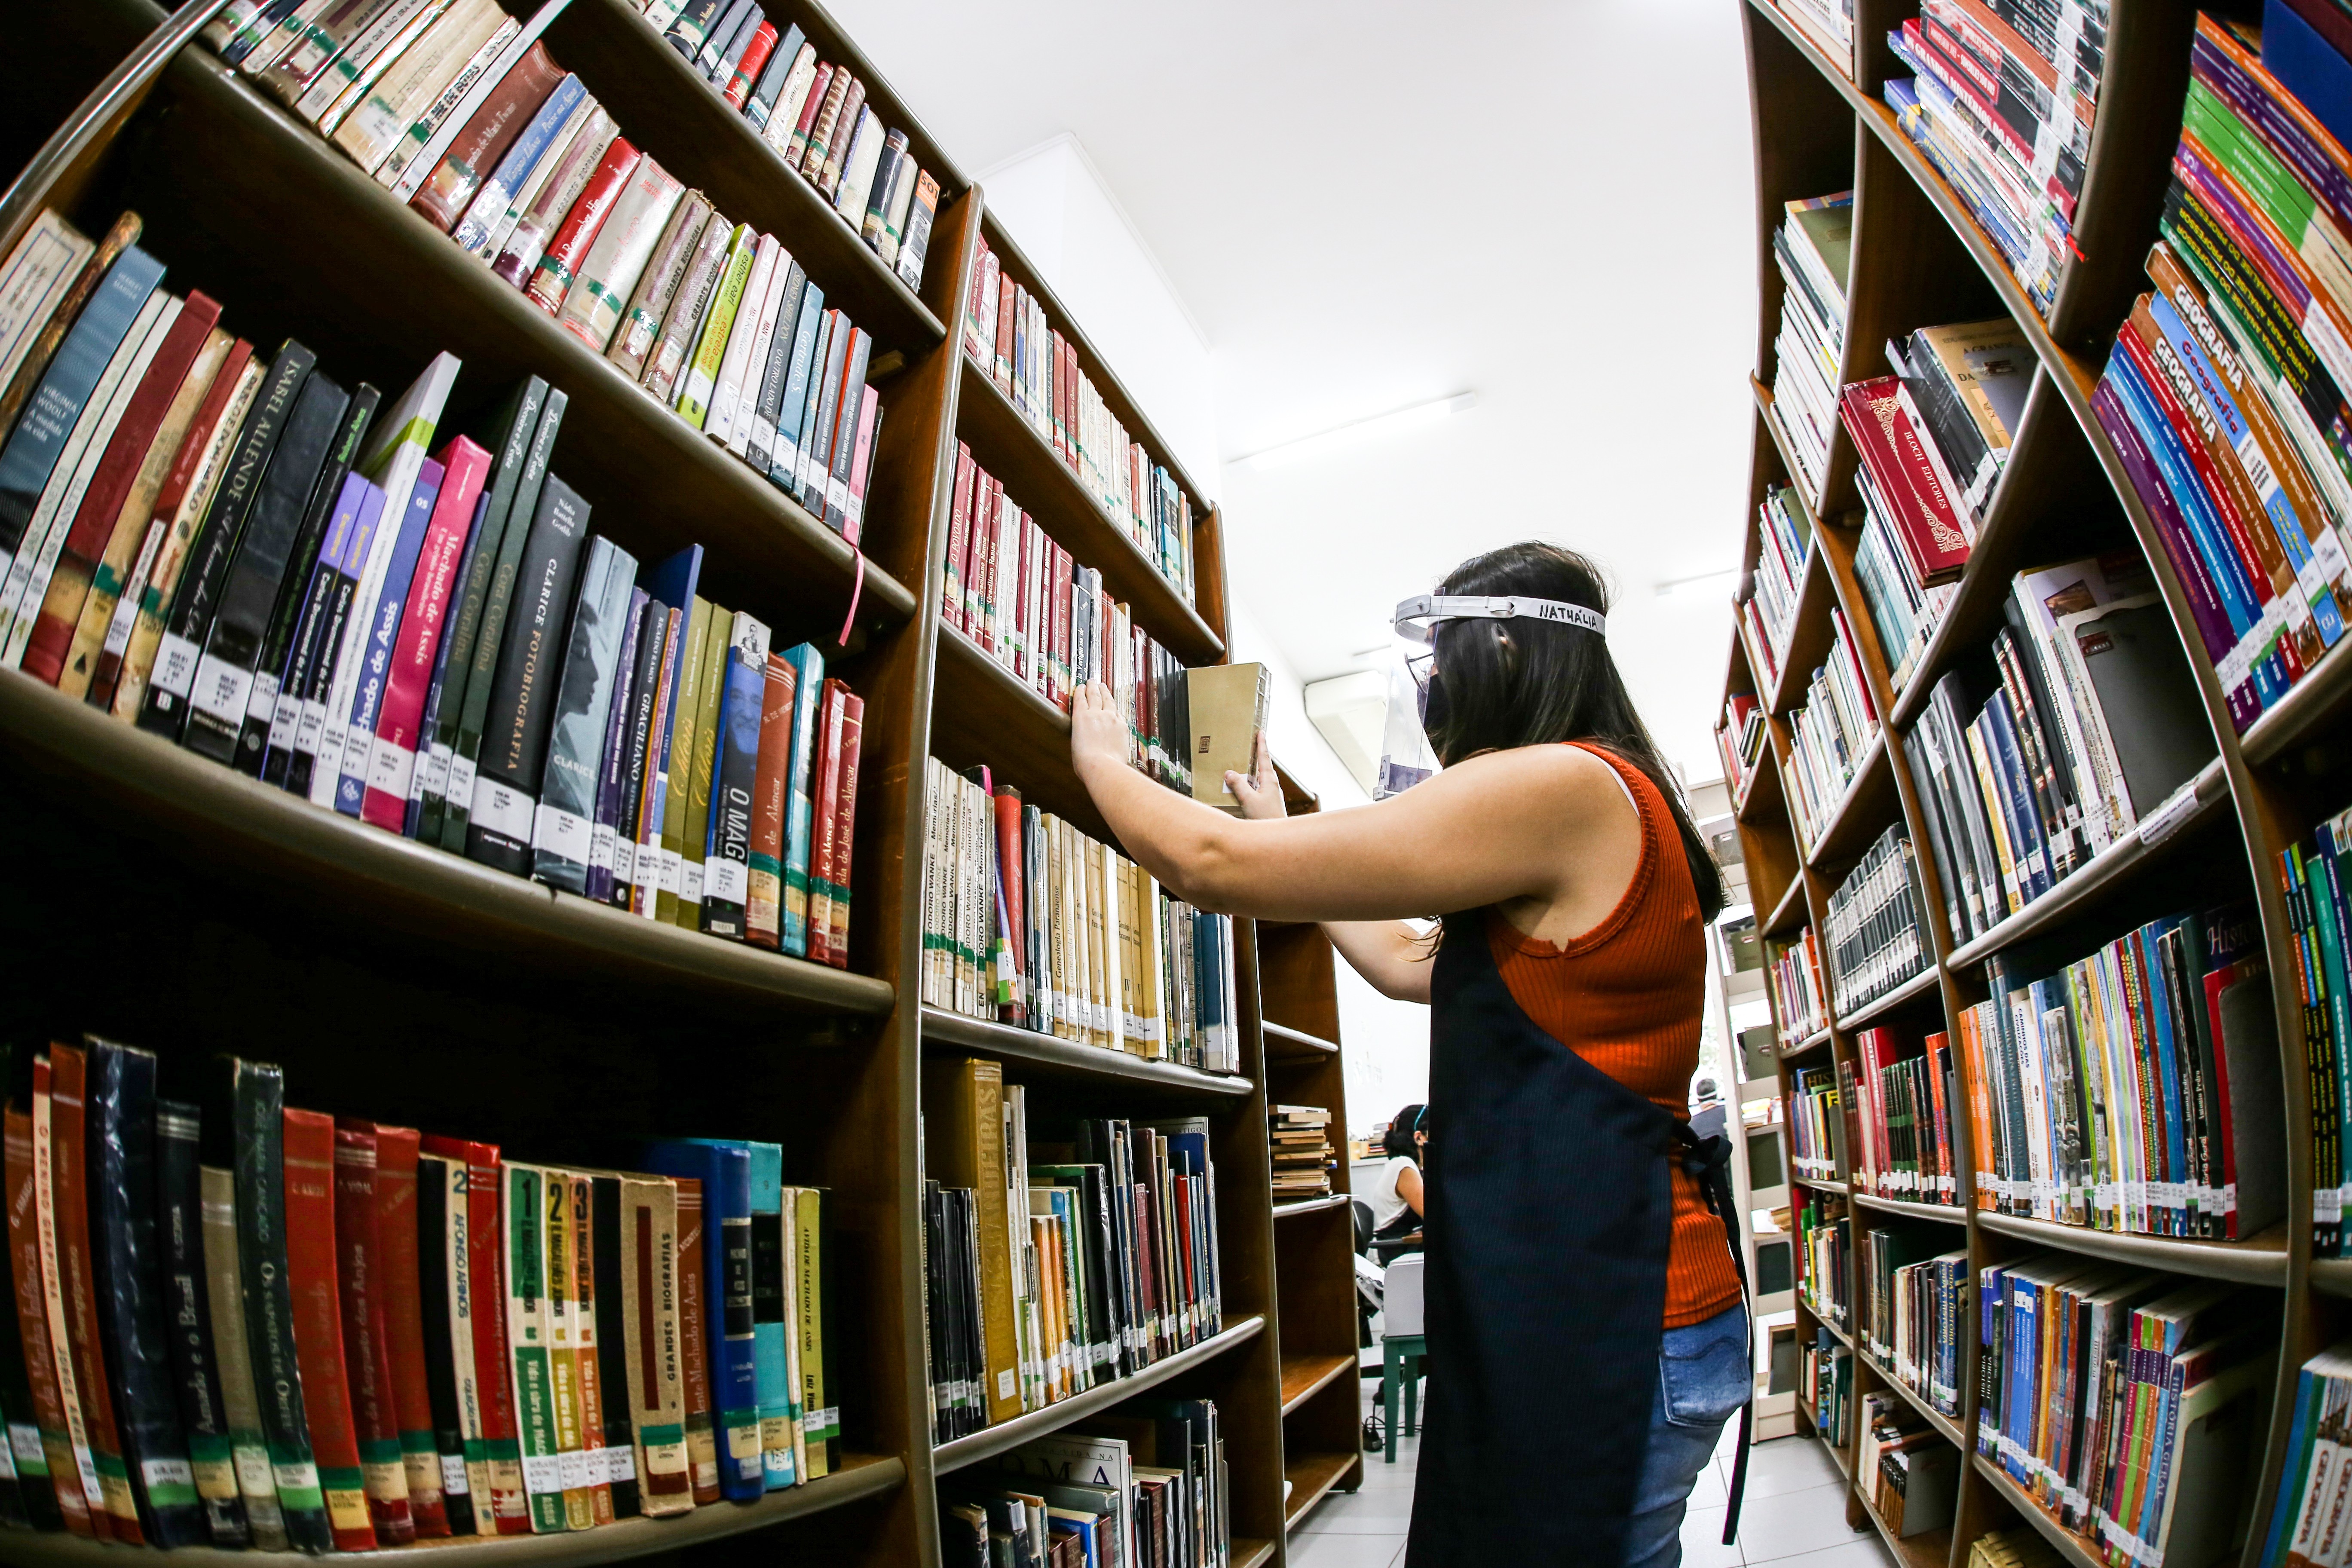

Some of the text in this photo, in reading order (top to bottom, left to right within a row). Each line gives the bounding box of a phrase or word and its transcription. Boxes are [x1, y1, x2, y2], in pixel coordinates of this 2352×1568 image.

[371, 4, 410, 42] QUE NÃO ERA
[1911, 43, 1951, 83] GRANDES
[1944, 75, 1998, 129] MISTÉRIOS
[476, 119, 502, 150] de Mark
[922, 175, 938, 199] 501
[619, 215, 641, 247] tempo
[662, 225, 703, 300] GRANDES BIOGRAFIAS
[727, 254, 751, 306] esther earl
[2182, 189, 2319, 364] LIVRO PARA ANÁLISE DO PROFESSOR
[788, 271, 802, 300] SIDNEY
[2178, 205, 2311, 381] LIVRO PARA ANÁLISE DO PROFESSOR
[710, 304, 727, 337] nunca vai
[778, 301, 795, 343] SHELDON
[2175, 222, 2306, 396] LIVRO PARA ANÁLISE DO PROFESSOR
[705, 321, 731, 370] estrela que
[736, 306, 757, 358] MAN Repeller
[749, 320, 771, 372] MAN Repeller
[2172, 282, 2248, 392] GEOGRAFIA
[771, 355, 783, 383] OUTRO
[790, 331, 815, 394] Gertrude S.
[1958, 372, 1976, 383] DA
[38, 397, 65, 420] WOOLF
[44, 385, 77, 414] VIRGINIA
[766, 383, 777, 406] LADO
[2153, 337, 2219, 441] GEOGRAFIA
[2178, 339, 2242, 435] Geografia
[229, 360, 299, 500] ISABEL ALLENDE
[763, 405, 772, 418] DE
[1902, 429, 1951, 511] BLOCH EDITORES
[2205, 470, 2227, 510] GEOGRAFIA
[416, 497, 427, 509] 05
[947, 509, 967, 562] O POVOADO
[979, 536, 988, 560] Ramos
[1043, 540, 1052, 569] GRACILIANO
[2184, 503, 2231, 593] MUNDO SUBDESENVOLVIDO
[984, 542, 998, 602] Graciliano Ramos
[2176, 527, 2218, 610] O MUNDO DESENVOLVIDO
[412, 532, 459, 666] Machado de Assis
[475, 563, 514, 671] Cora Coralina
[1041, 590, 1049, 617] MEMÓRIAS
[1539, 604, 1599, 630] NATHÁLIA
[371, 600, 398, 674] de Assis
[1058, 598, 1069, 658] Meus Verdes Anos
[505, 559, 557, 769] CLARICE FOTOBIOGRAFIA
[629, 693, 652, 781] GRACILIANO
[554, 754, 594, 779] CLARICE
[729, 787, 750, 805] O
[766, 778, 780, 845] de Alencar
[836, 764, 855, 864] de José de Alencar
[824, 818, 833, 856] Alencar
[1053, 885, 1063, 977] Genealogia Paranaense
[978, 992, 984, 1007] EN
[1124, 978, 1130, 992] IV
[2014, 1014, 2024, 1065] CIVILIZAÇÕES
[2335, 994, 2352, 1124] GEOGRAFIA GERAL
[2136, 1060, 2145, 1099] HISTÓRIA
[1172, 1125, 1202, 1136] ANTIGO
[2321, 1121, 2327, 1134] DO
[2330, 1114, 2335, 1129] DO
[2142, 1124, 2151, 1176] NAVEGANDO
[2199, 1136, 2209, 1161] Geral
[522, 1179, 532, 1217] 1
[550, 1184, 562, 1221] 2
[575, 1183, 587, 1218] 3
[451, 1170, 470, 1318] 2 AFONSO ARINOS
[661, 1234, 676, 1380] GRANDES BIOGRAFIAS
[683, 1273, 702, 1381] Machado de Assis
[1941, 1300, 1949, 1344] HISTÓRIA
[1947, 1302, 1957, 1346] HISTÓRIA
[806, 1375, 815, 1389] Luiz
[1978, 1354, 1988, 1397] HISTÓRIA
[1984, 1356, 1995, 1400] HISTÓRIA
[1099, 1452, 1114, 1461] NA
[2154, 1376, 2184, 1500] HISTÓRIA GERAL
[2298, 1449, 2331, 1546] GEOGRAFIA
[2318, 1457, 2352, 1559] GEOGRAFIA
